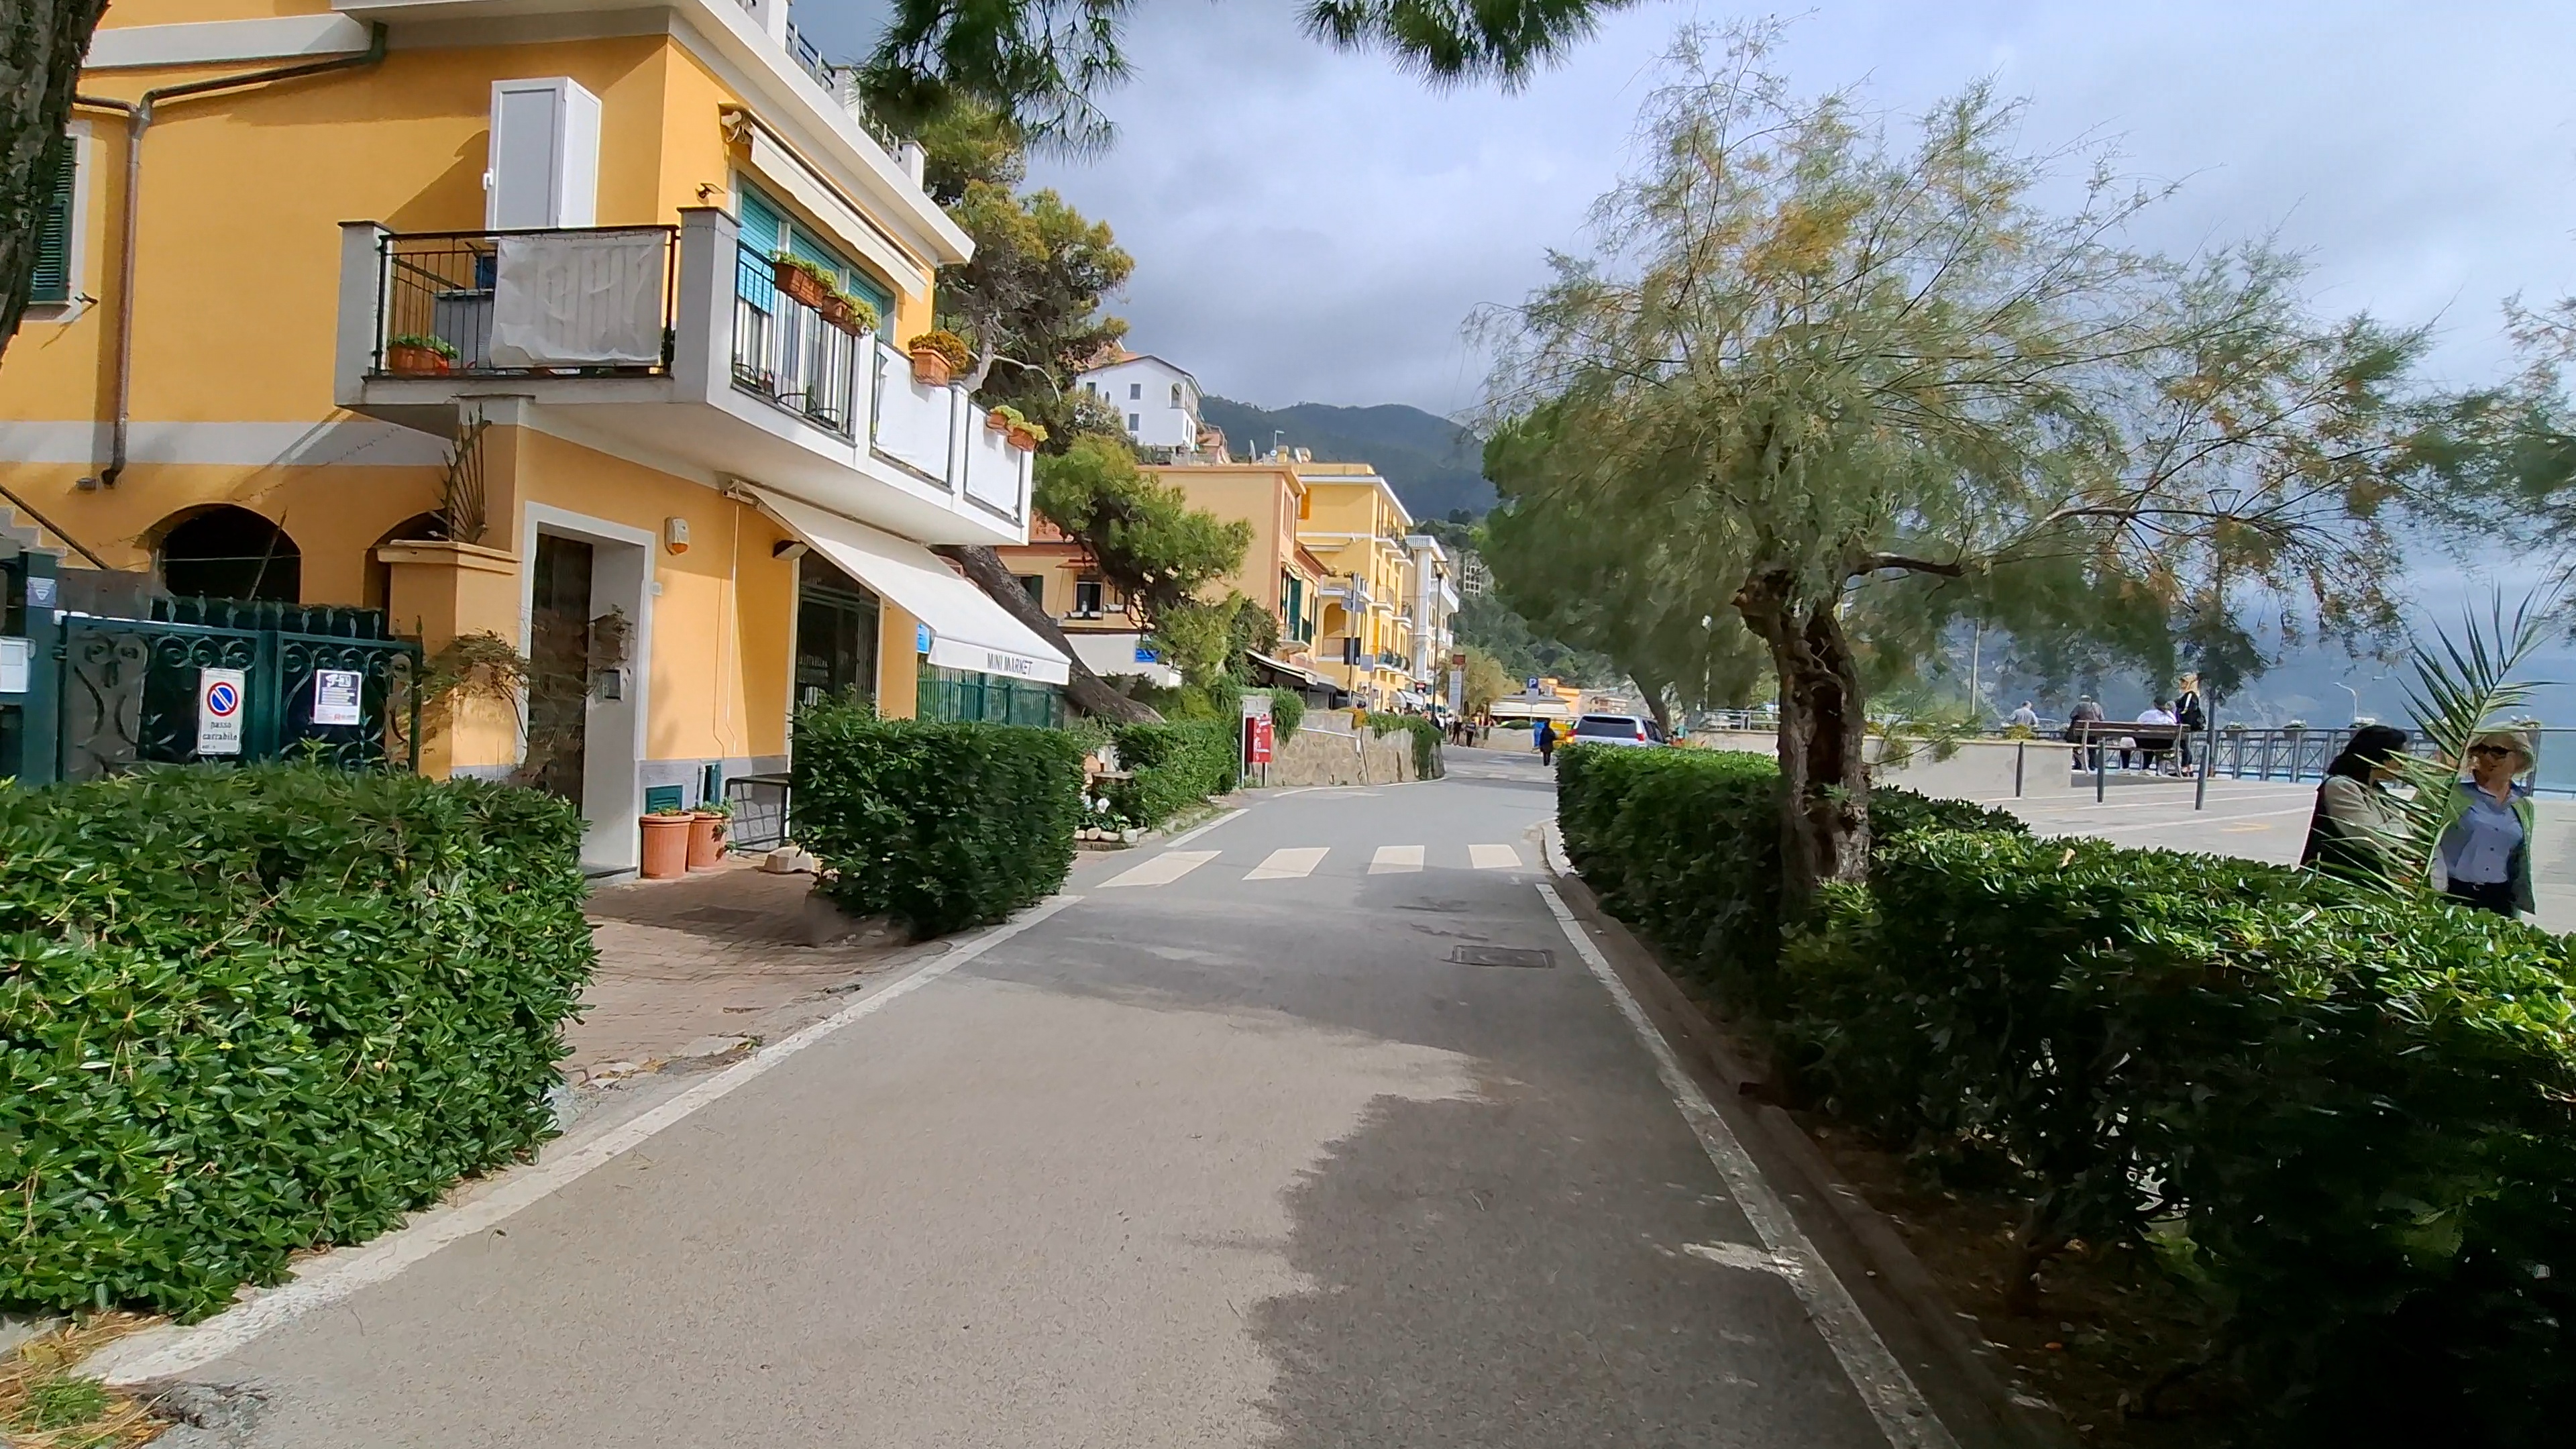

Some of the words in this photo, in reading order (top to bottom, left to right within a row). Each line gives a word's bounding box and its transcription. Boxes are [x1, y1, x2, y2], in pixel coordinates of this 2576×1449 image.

[987, 653, 1002, 670] MINI
[1004, 657, 1033, 676] MARKET
[1529, 678, 1537, 688] P
[203, 732, 237, 741] carrabile
